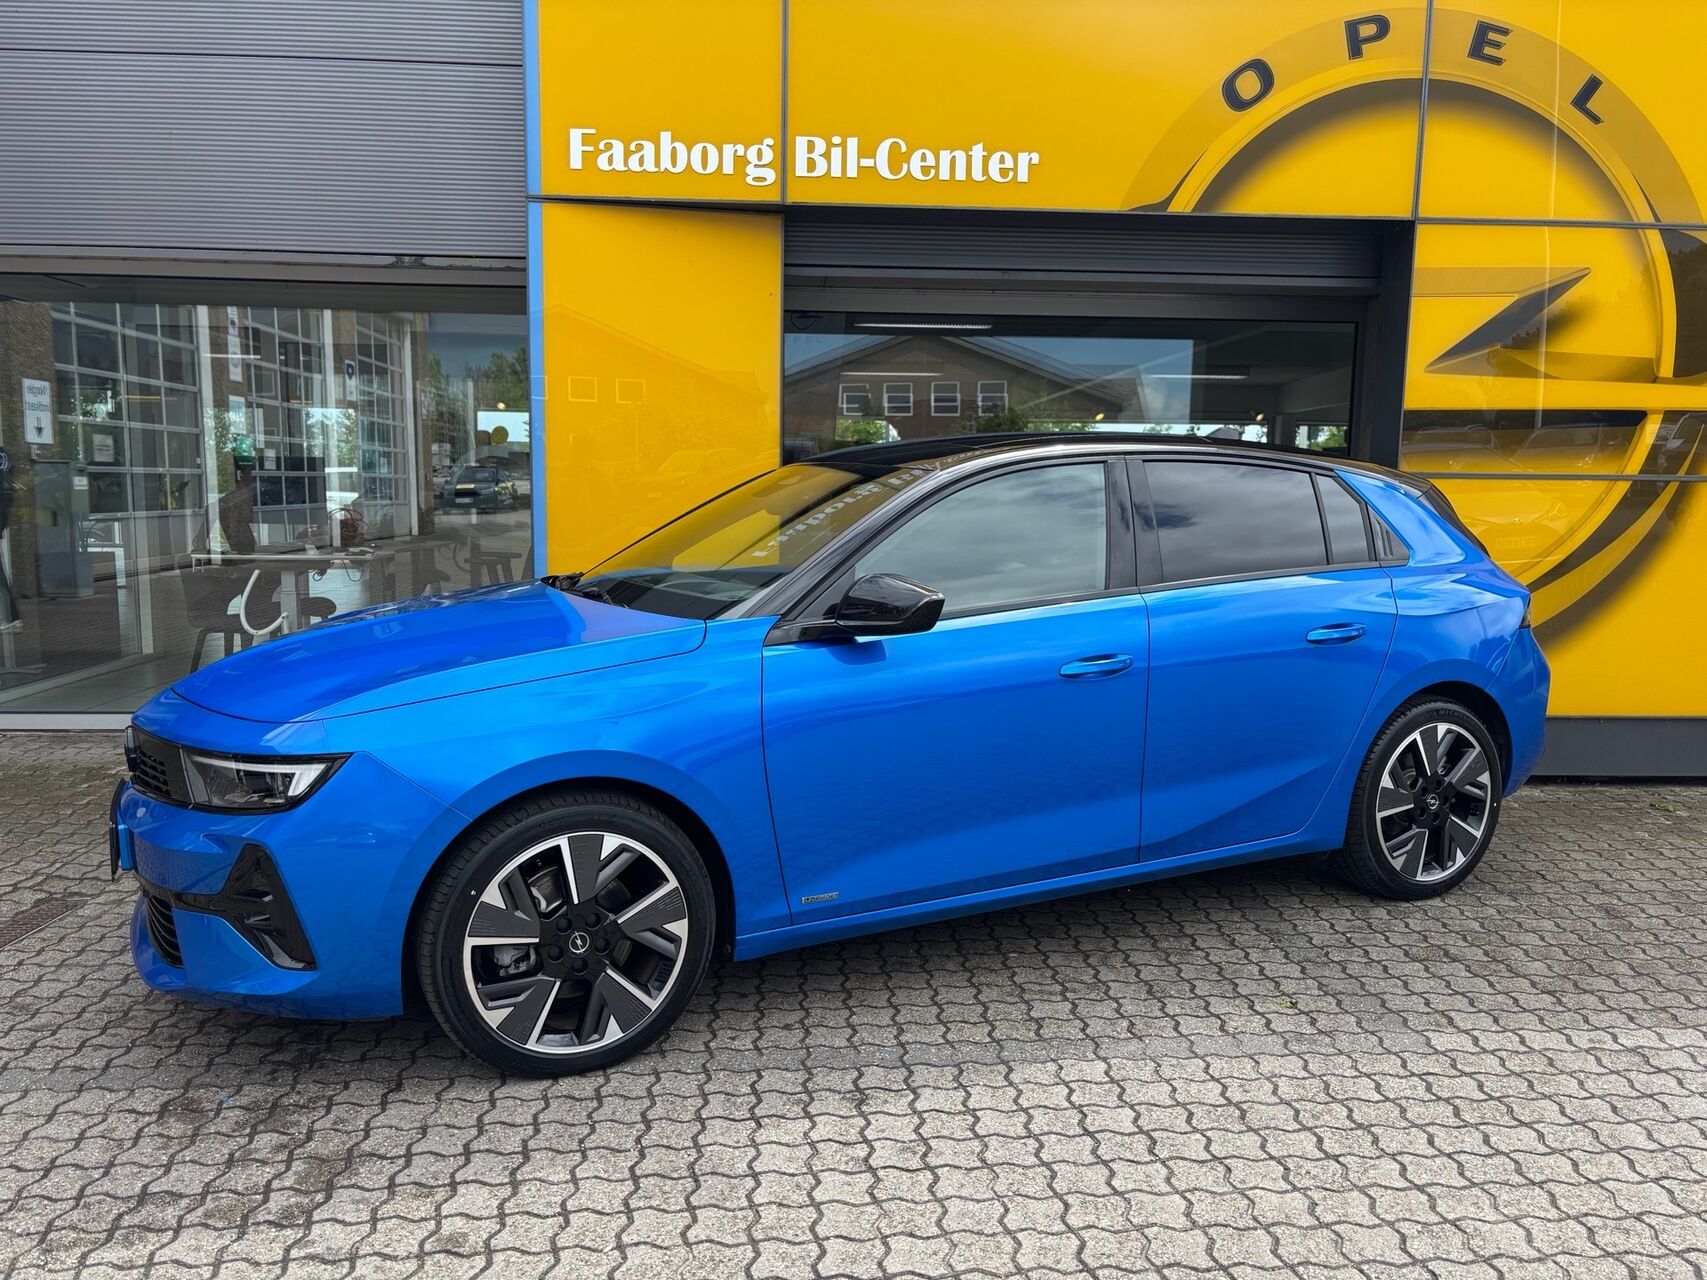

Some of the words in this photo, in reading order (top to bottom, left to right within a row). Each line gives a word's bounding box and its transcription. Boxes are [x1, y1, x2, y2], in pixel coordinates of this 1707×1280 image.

[1222, 14, 1604, 126] OPEL
[569, 128, 776, 186] Faaborg
[795, 135, 1040, 183] Bil-Center
